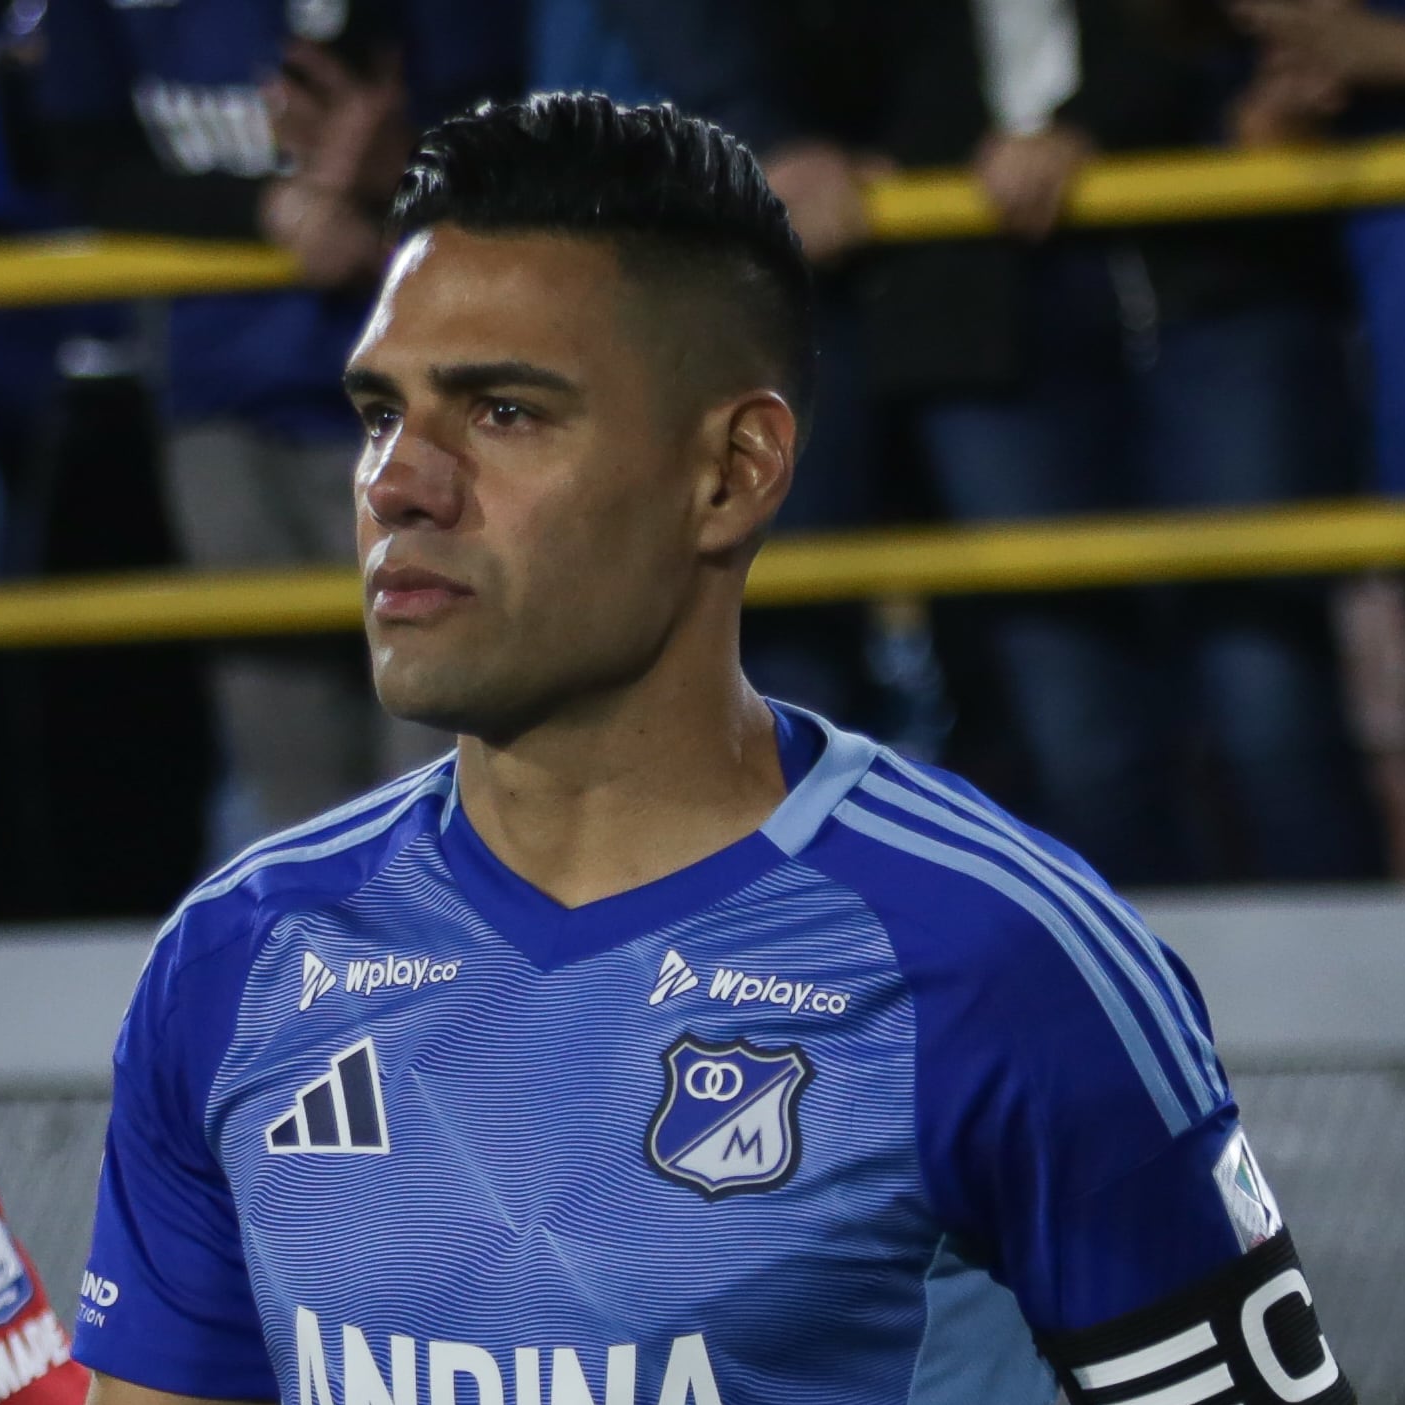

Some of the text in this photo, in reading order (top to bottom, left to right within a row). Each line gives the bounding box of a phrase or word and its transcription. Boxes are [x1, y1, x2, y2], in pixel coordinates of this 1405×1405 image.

[345, 954, 459, 996] Wplay.co
[709, 968, 849, 1014] Wplay.co
[722, 1125, 762, 1166] M
[1241, 1268, 1339, 1403] C
